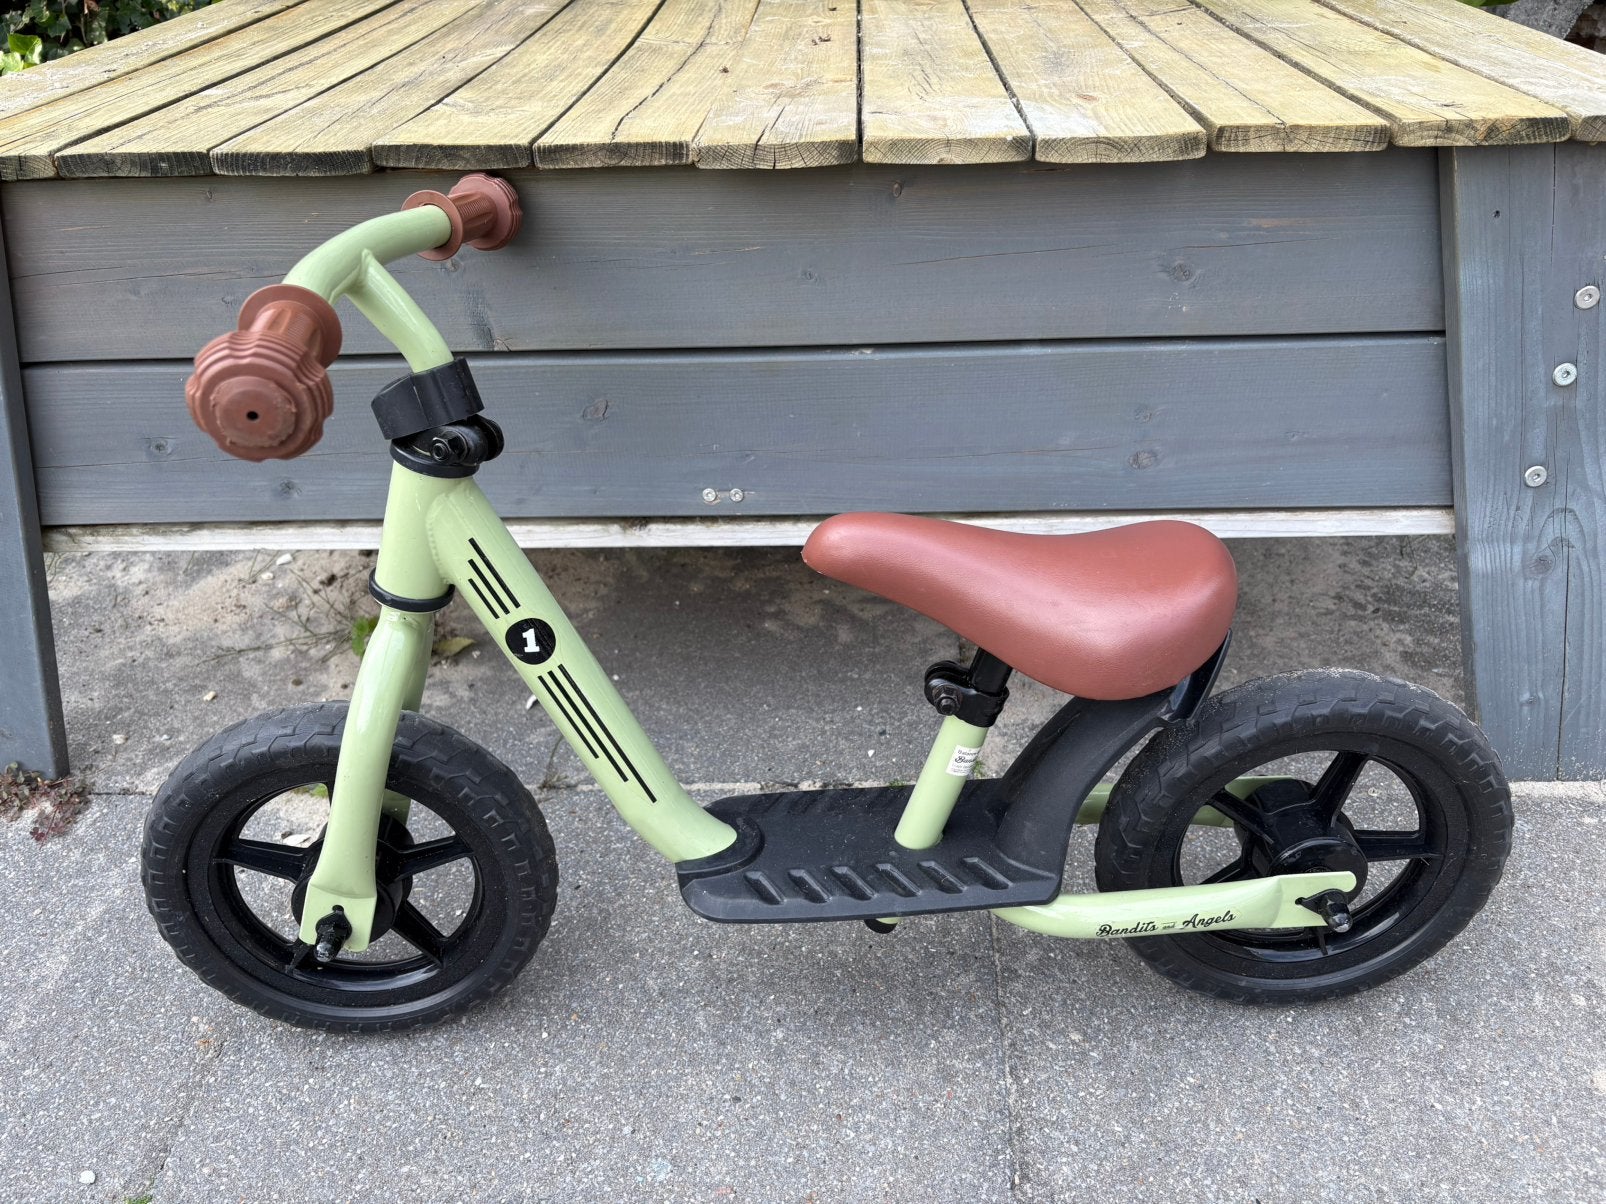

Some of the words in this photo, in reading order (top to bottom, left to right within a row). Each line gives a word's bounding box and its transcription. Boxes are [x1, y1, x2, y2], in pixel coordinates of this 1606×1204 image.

[522, 628, 540, 653] 1
[1096, 921, 1158, 937] Bandits
[1182, 910, 1237, 929] Angels
